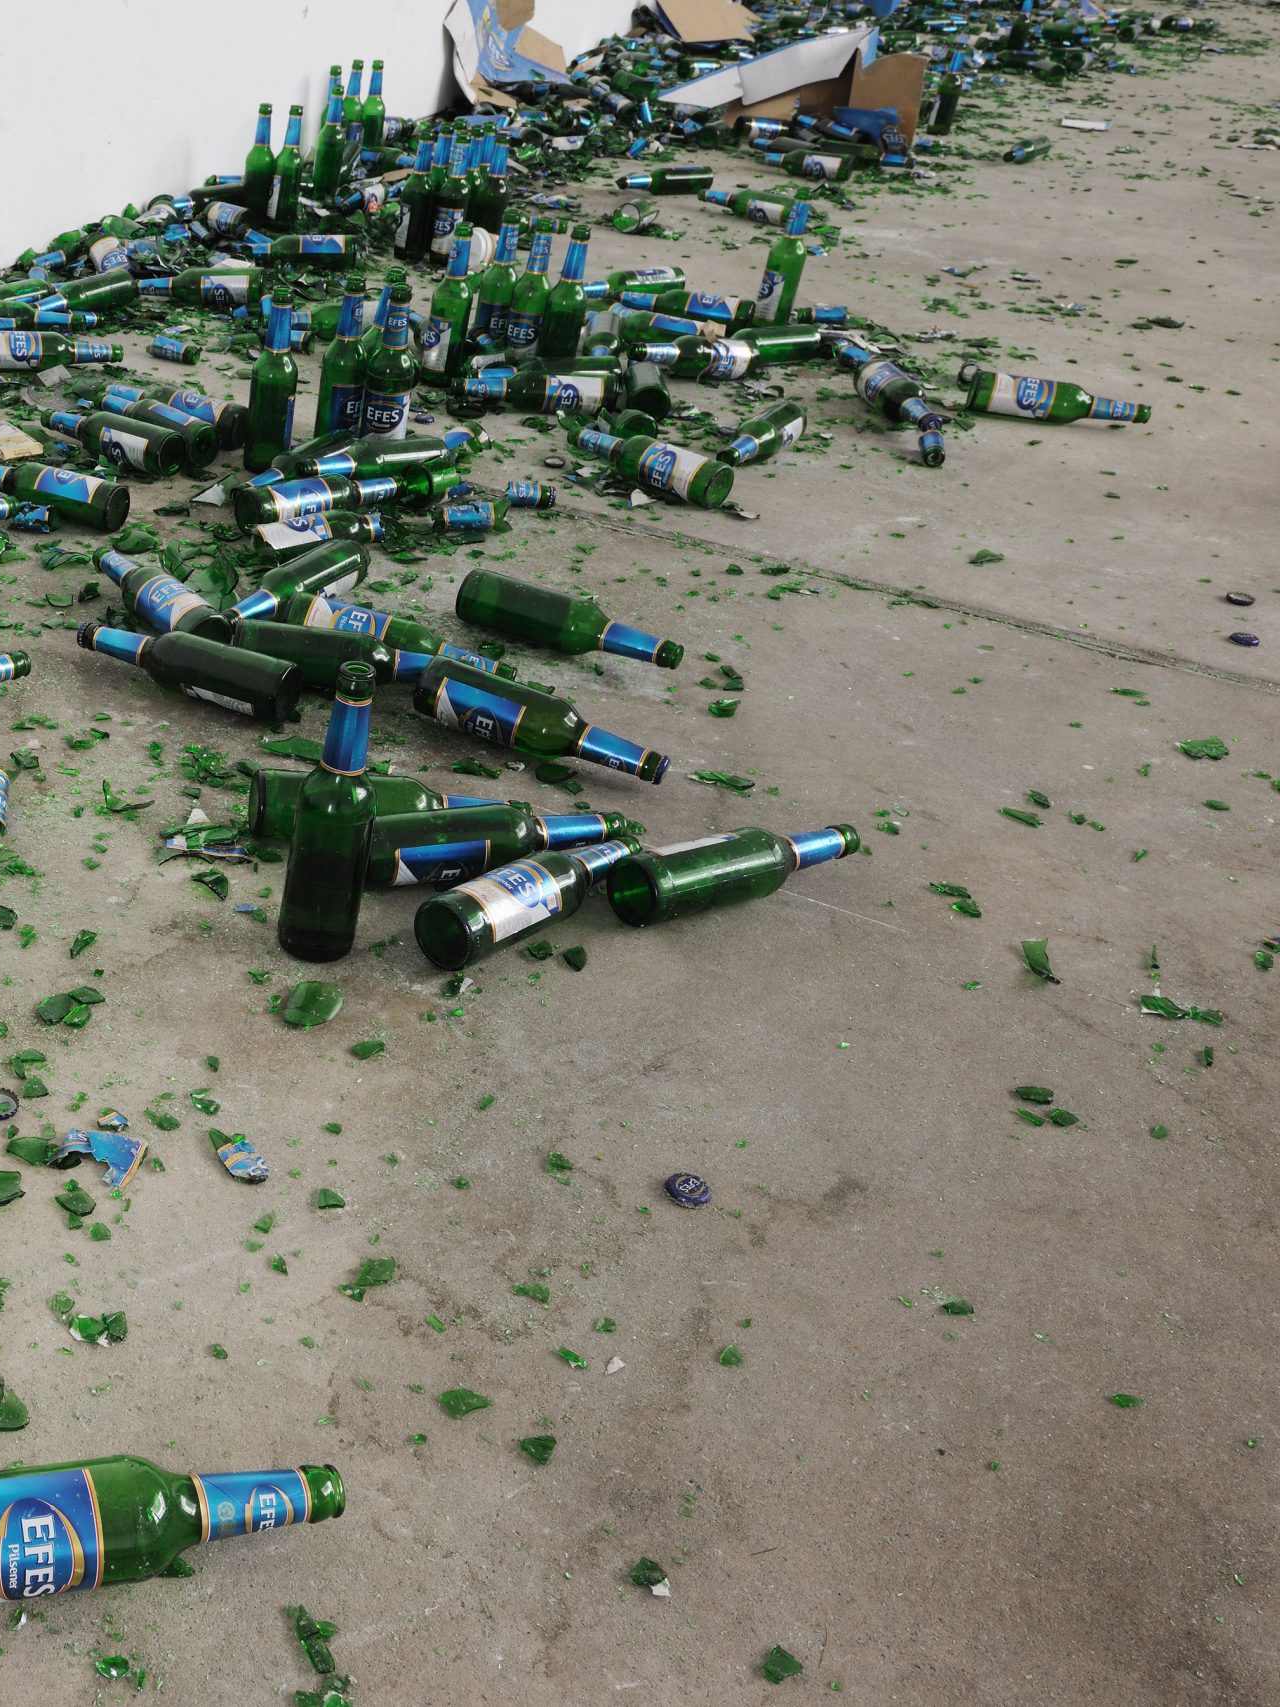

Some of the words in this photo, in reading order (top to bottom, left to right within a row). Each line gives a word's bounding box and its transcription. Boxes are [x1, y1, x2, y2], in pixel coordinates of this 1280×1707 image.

[366, 408, 398, 423] EFES
[7, 1543, 20, 1590] Pilsener
[19, 1512, 56, 1599] EFES
